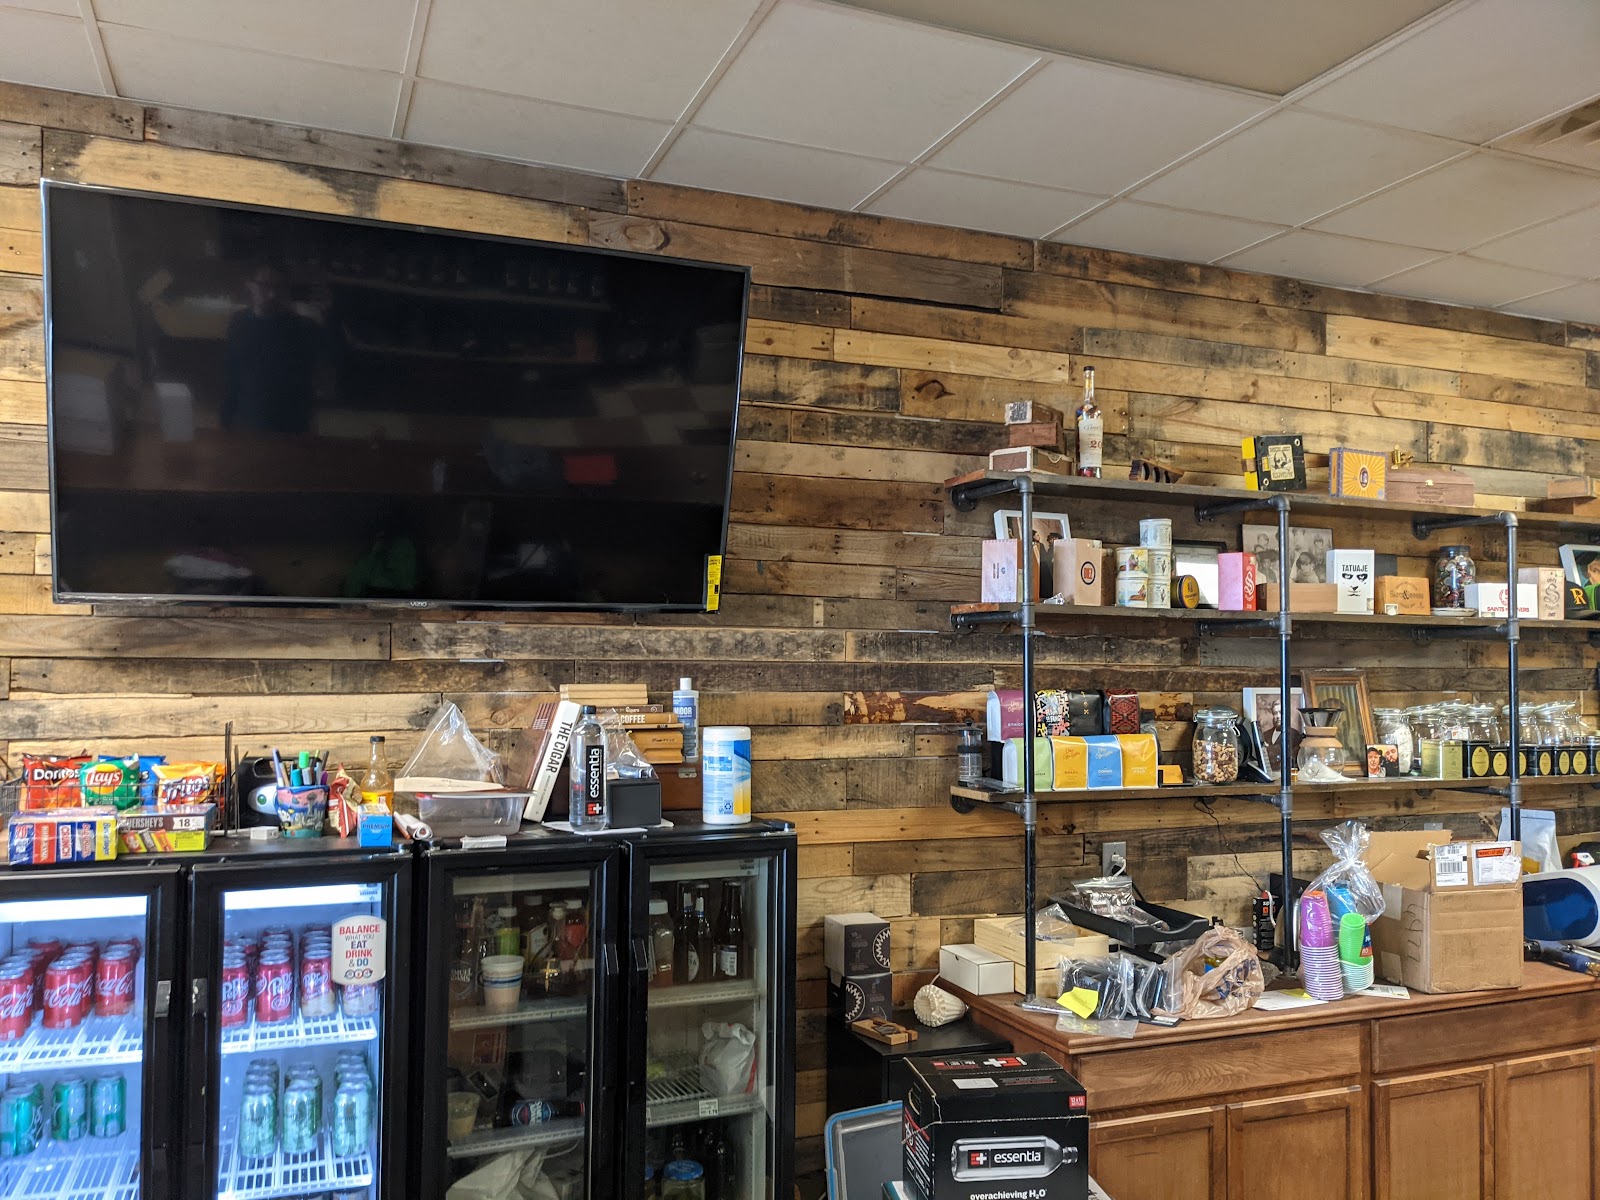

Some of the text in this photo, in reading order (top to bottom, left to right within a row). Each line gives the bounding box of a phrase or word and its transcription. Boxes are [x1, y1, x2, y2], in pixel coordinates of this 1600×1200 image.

[1341, 564, 1368, 572] TATUAJE
[620, 714, 646, 724] COFFEE
[545, 721, 573, 773] THE CIGAR
[34, 768, 80, 781] Doritos
[89, 770, 121, 786] Lay's
[589, 748, 600, 798] essentia
[161, 776, 210, 803] Fritos
[128, 816, 164, 829] HERSHEY'S
[179, 818, 190, 827] 18
[61, 826, 71, 857] CRUNCH
[339, 924, 380, 935] BALANCE
[345, 934, 361, 942] WHAT
[351, 940, 367, 949] EAT
[345, 949, 373, 959] DRINK
[356, 958, 369, 967] DO
[994, 1151, 1041, 1164] essentia
[970, 1190, 1028, 1200] overachieving
